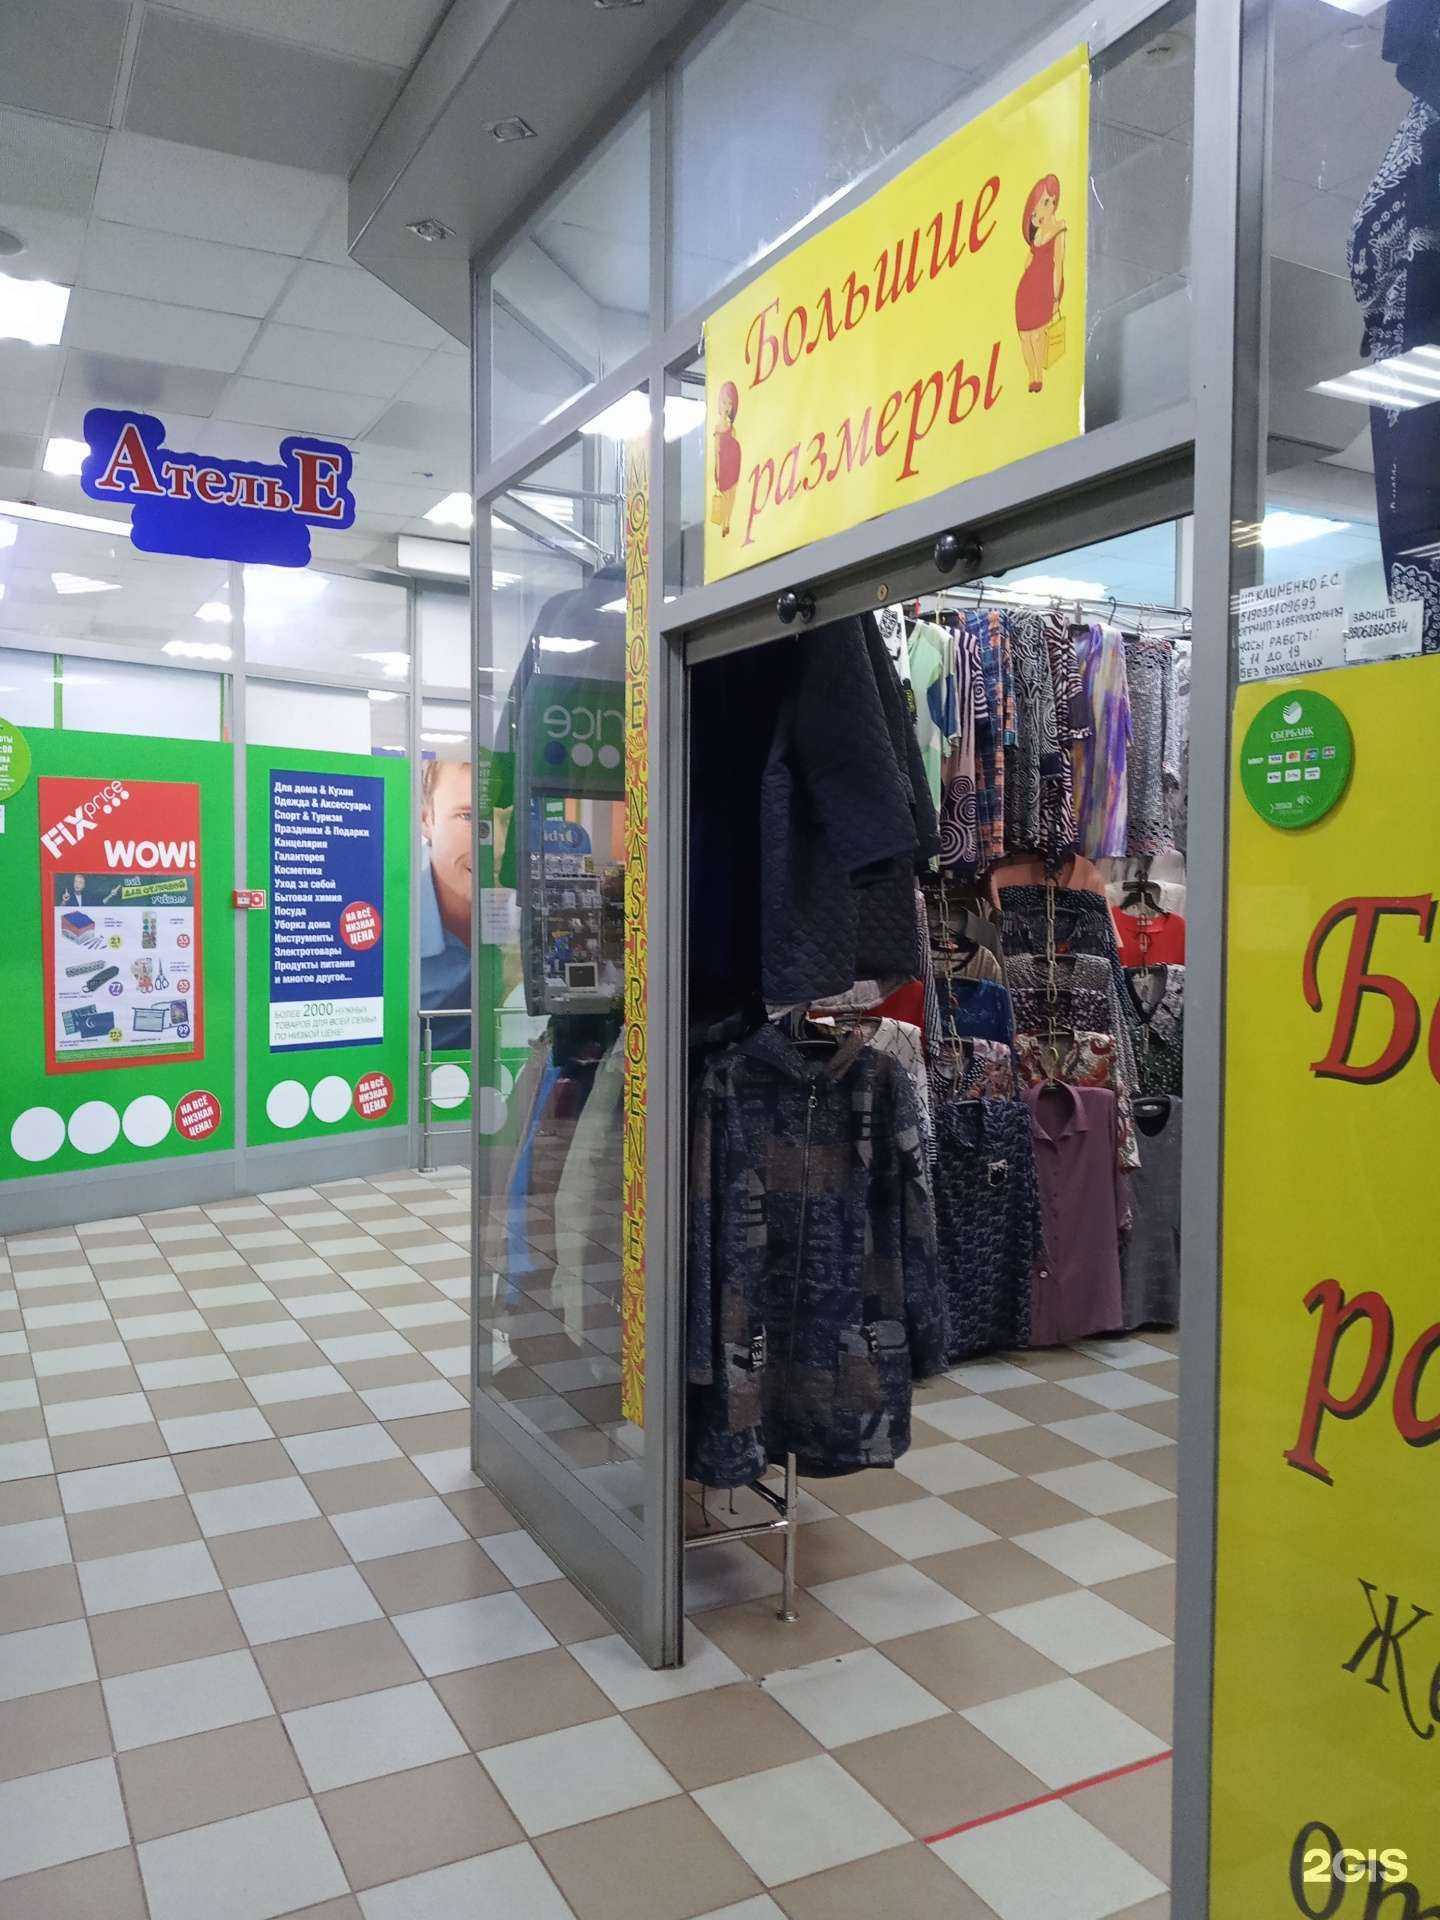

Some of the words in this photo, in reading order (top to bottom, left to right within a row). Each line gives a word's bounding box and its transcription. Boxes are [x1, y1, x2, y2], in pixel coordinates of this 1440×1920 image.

[744, 175, 1001, 390] Большие
[740, 341, 1003, 548] размеры
[94, 423, 346, 520] АтельЕ
[274, 782, 293, 793] Для
[294, 784, 318, 795] дома
[328, 786, 354, 797] Кухни
[274, 796, 310, 808] Одежда
[320, 799, 371, 812] Аксессуары
[274, 809, 301, 822] Спорт
[311, 811, 343, 823] Туризм
[274, 823, 323, 835] Праздники
[333, 826, 370, 838] Подарки
[274, 837, 328, 850] Канцелярия
[104, 839, 196, 869] WOW!
[274, 851, 325, 863] Галантерея
[274, 865, 323, 875] Косметика
[274, 879, 297, 889] Уход
[310, 879, 336, 889] собой
[274, 893, 313, 902] Бытовая
[314, 894, 343, 902] химия
[274, 906, 307, 917] Посуда
[274, 920, 306, 931] Уборка
[307, 921, 331, 930] дома
[274, 934, 334, 944] Инструменты
[274, 947, 342, 958] Электротовары
[274, 961, 319, 972] Продукты
[320, 960, 355, 969] питания
[282, 975, 315, 984] многое
[1303, 893, 1440, 1085] Б
[303, 1002, 334, 1017] 2000
[1341, 1577, 1440, 1740] Ж
